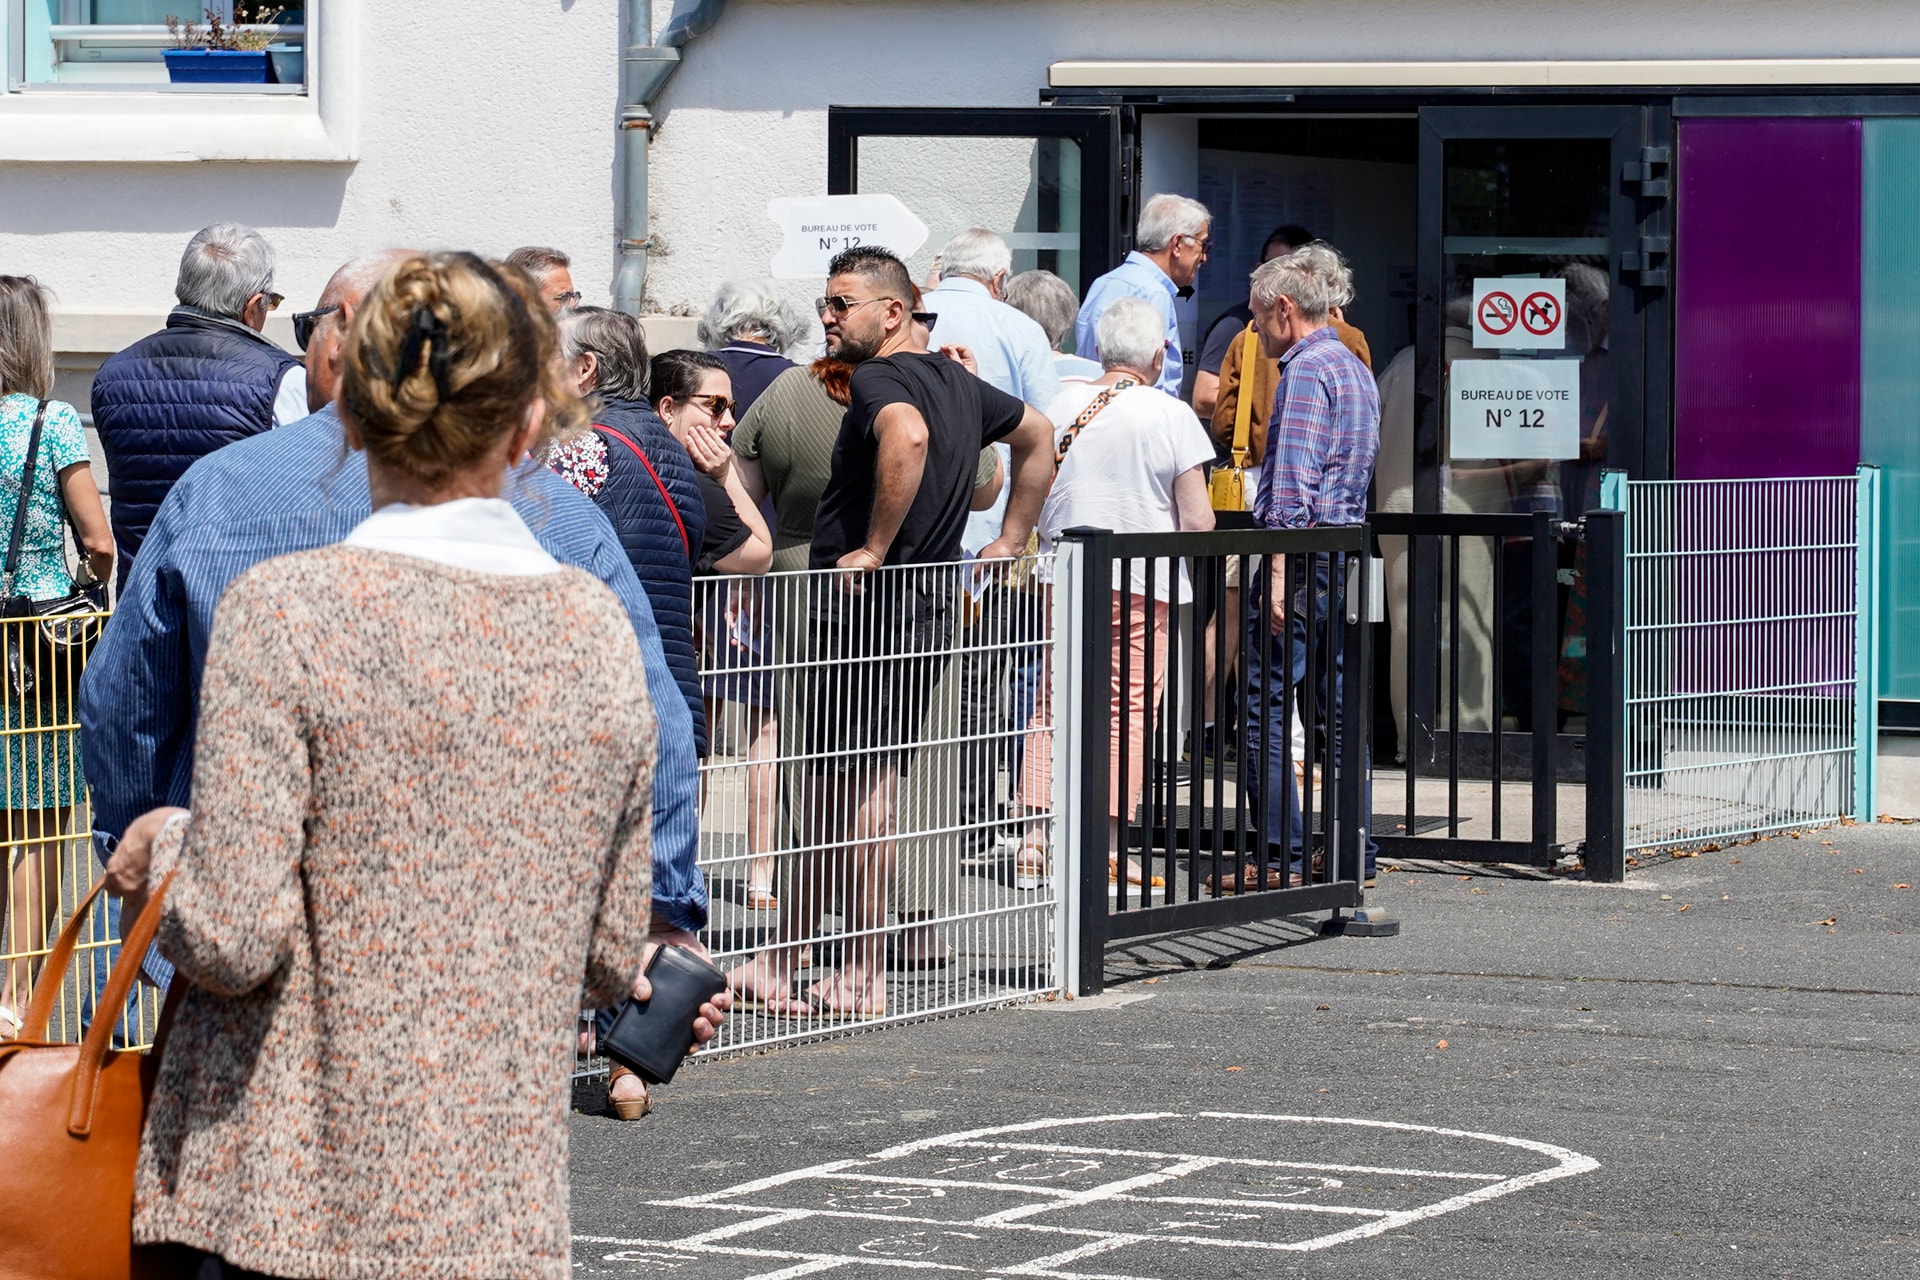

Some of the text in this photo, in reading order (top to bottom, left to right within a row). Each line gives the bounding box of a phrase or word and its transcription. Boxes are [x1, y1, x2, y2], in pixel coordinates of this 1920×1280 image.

[819, 236, 861, 250] N° 12
[1183, 348, 1193, 364] ÉE
[1461, 390, 1569, 400] BUREAU DE VOTE
[1486, 409, 1545, 428] N° 12
